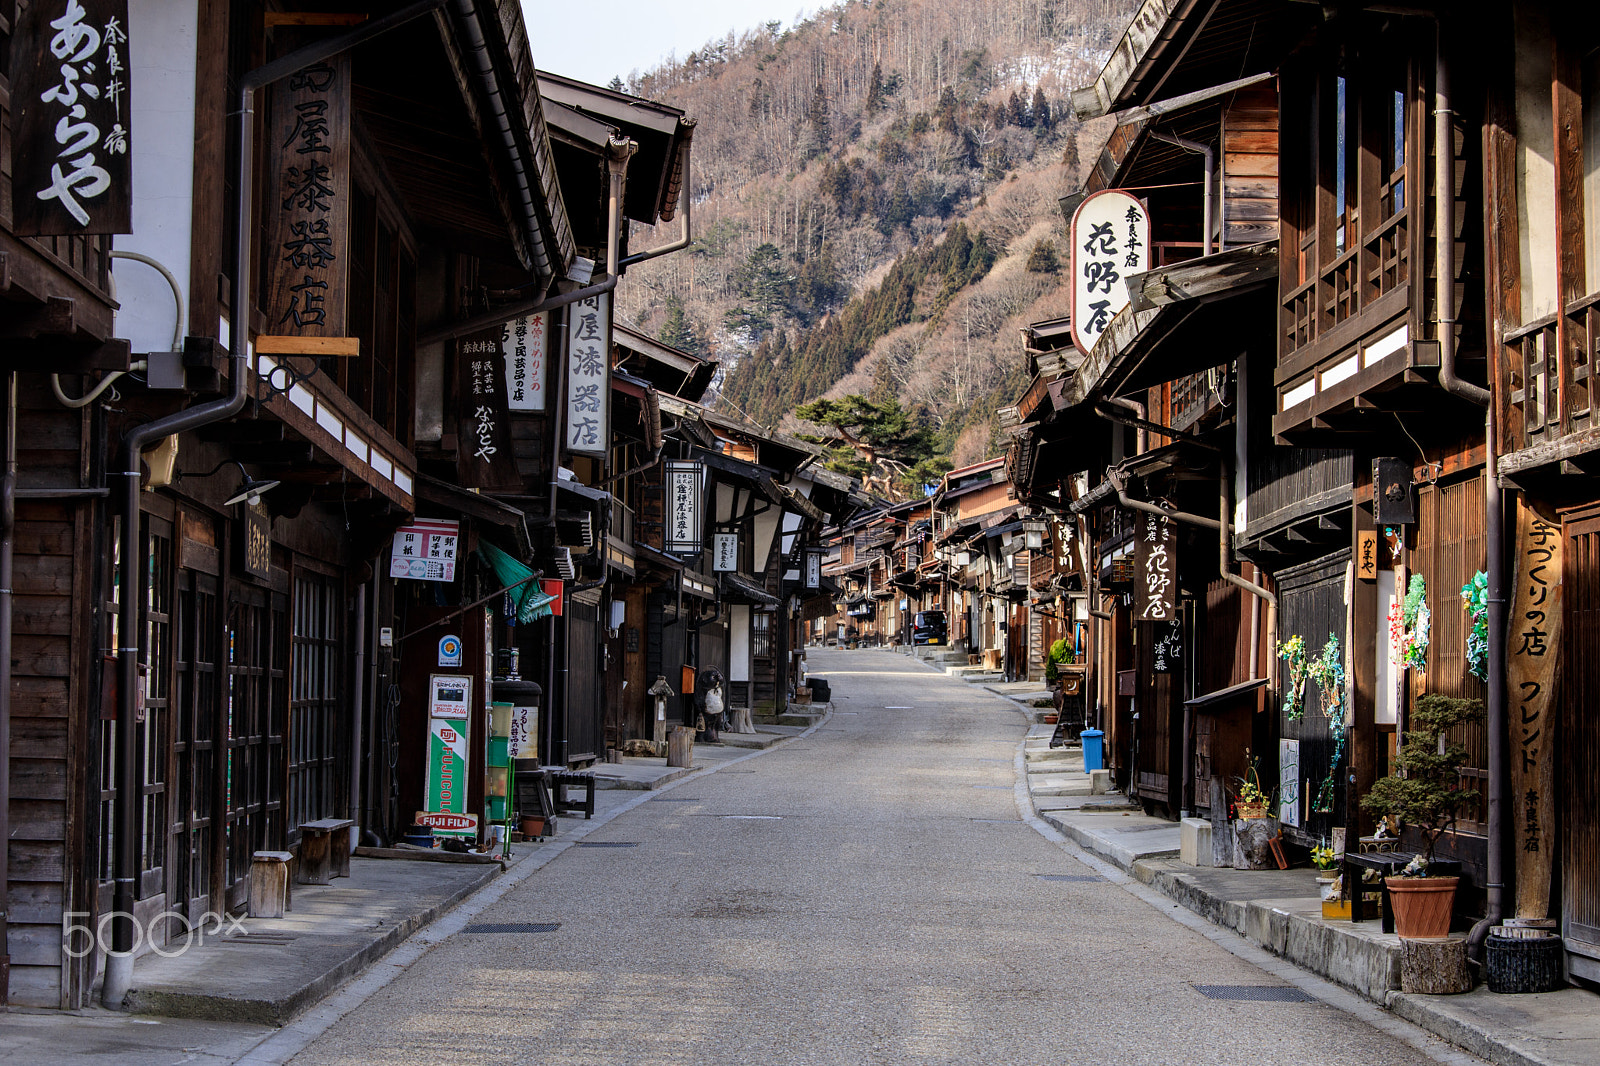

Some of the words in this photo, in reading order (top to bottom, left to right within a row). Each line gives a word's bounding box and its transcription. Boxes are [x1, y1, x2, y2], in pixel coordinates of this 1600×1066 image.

[37, 0, 111, 227] あぶらや
[103, 16, 127, 155] 奈良井宿
[1124, 205, 1143, 268] 奈良井宿
[1083, 221, 1120, 335] 花野屋
[463, 340, 496, 353] 奈良井宿
[473, 405, 497, 463] ながとや
[402, 533, 414, 556] 印紙
[444, 537, 455, 559] 郵便
[1360, 537, 1376, 574] かまや
[1142, 544, 1172, 619] 花野屋
[1515, 519, 1557, 657] 手づくりの店
[1519, 681, 1542, 774] フレンド
[423, 816, 445, 826] FUJI
[447, 818, 470, 828] FILM
[1523, 787, 1540, 854] 奈良井宿
